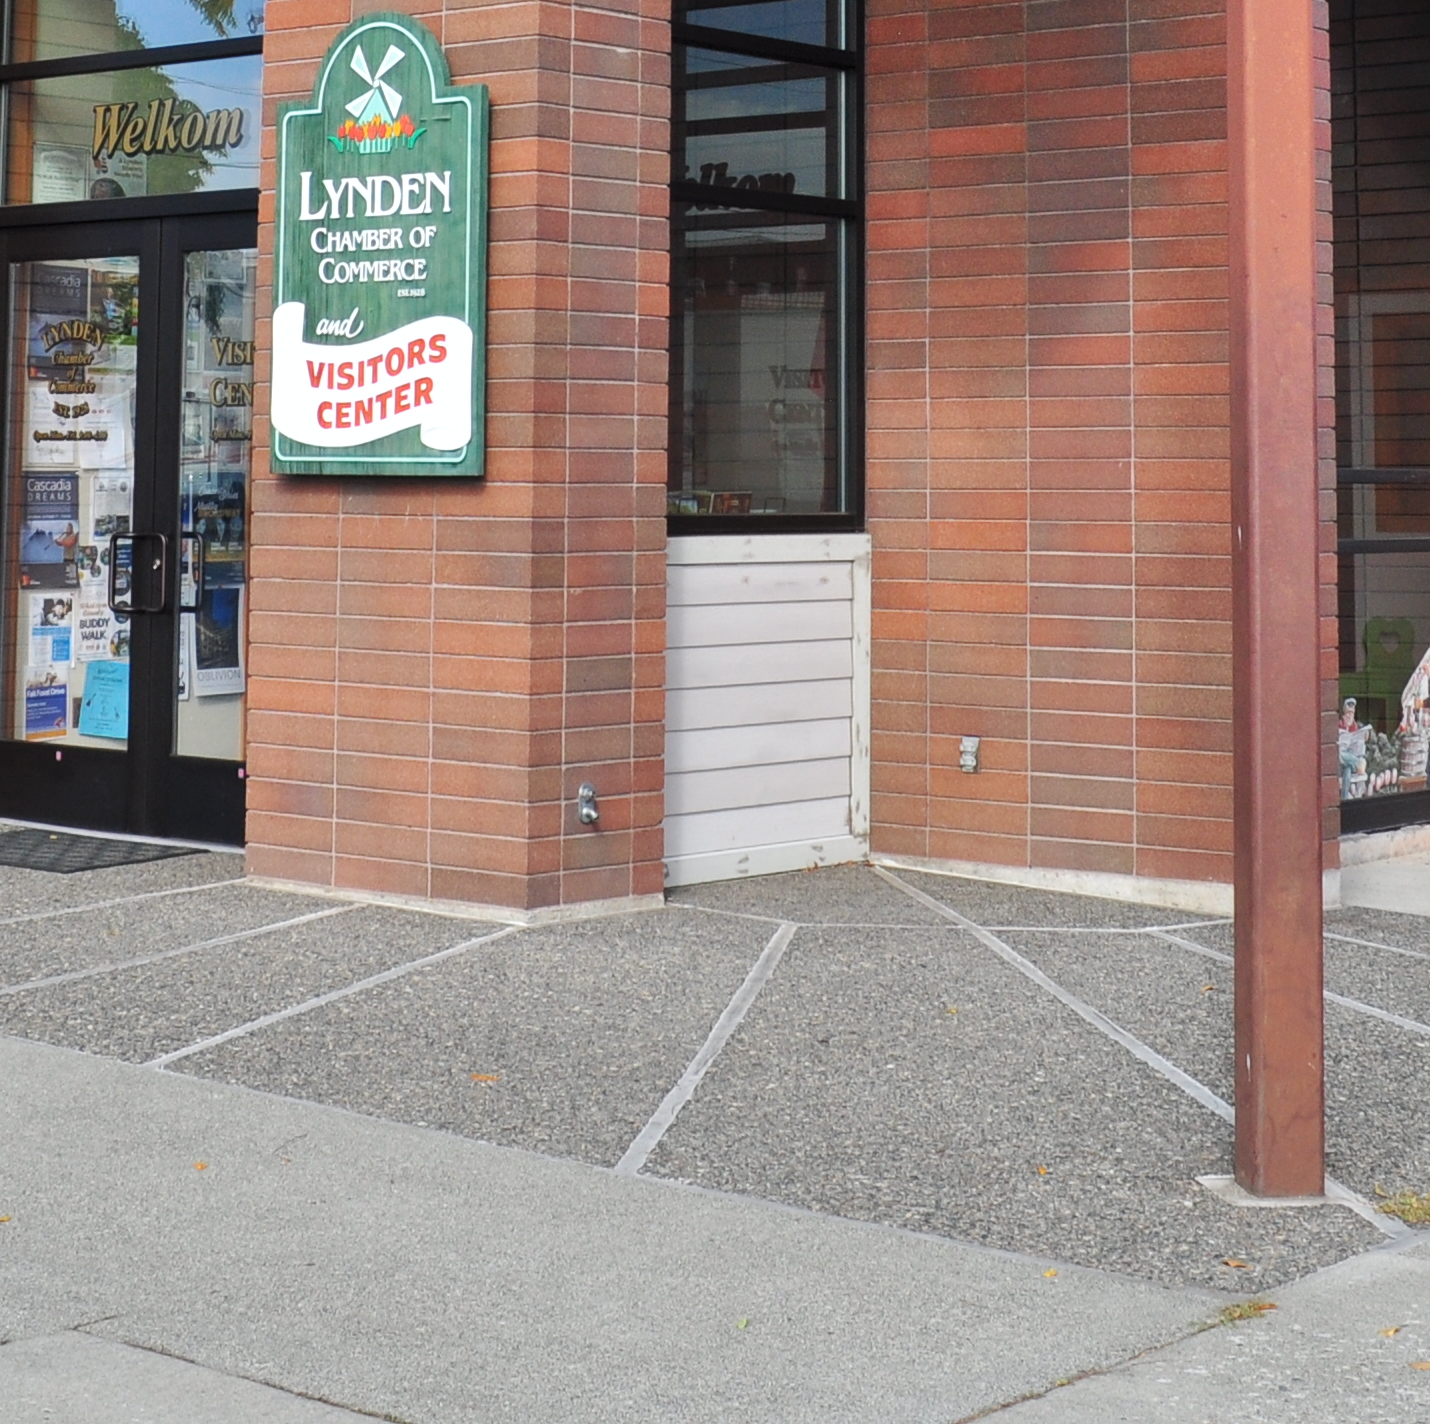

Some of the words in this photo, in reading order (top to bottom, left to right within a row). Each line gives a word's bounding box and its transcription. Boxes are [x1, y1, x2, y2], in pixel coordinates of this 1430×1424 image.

[93, 97, 244, 159] Welkom
[299, 170, 452, 221] LYNDEN
[310, 226, 403, 254] CHAMBER
[408, 224, 437, 249] OF
[317, 257, 428, 285] COMMERCE
[42, 319, 106, 352] LYNDEN
[315, 306, 365, 339] and
[51, 350, 95, 367] Chamber
[210, 336, 256, 367] VISI
[306, 333, 447, 391] VISITORS
[47, 380, 97, 395] Commerce
[66, 366, 77, 382] of
[315, 376, 435, 430] CENTER
[26, 478, 73, 492] Cascadia
[27, 491, 72, 502] DREAMS
[79, 617, 111, 630] BUDDY
[80, 629, 108, 641] WALK
[196, 668, 242, 682] OBLIVION
